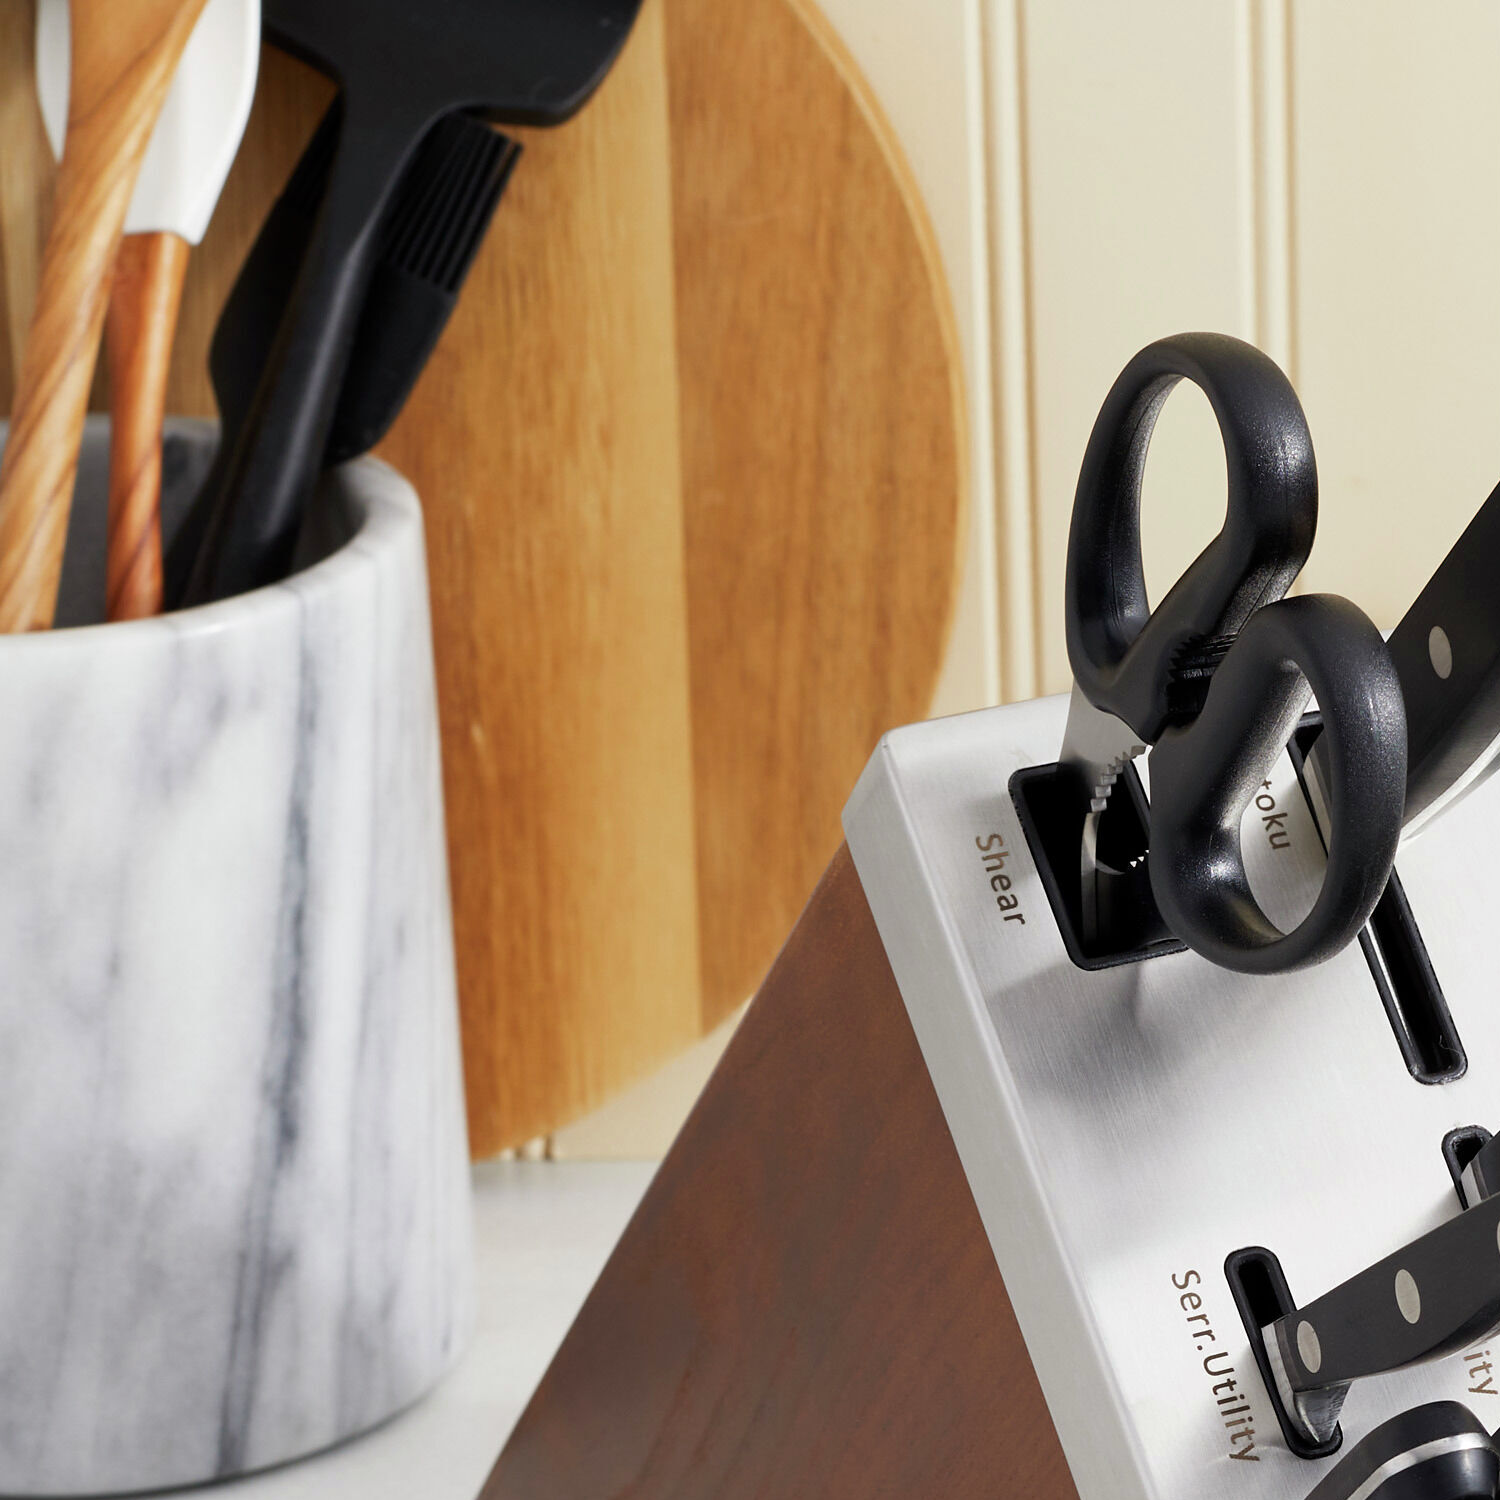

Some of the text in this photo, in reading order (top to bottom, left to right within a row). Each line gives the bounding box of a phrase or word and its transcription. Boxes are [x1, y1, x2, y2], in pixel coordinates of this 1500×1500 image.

[1255, 779, 1291, 850] toku
[975, 833, 1026, 925] Shear
[1171, 1269, 1260, 1462] Serr.Utility
